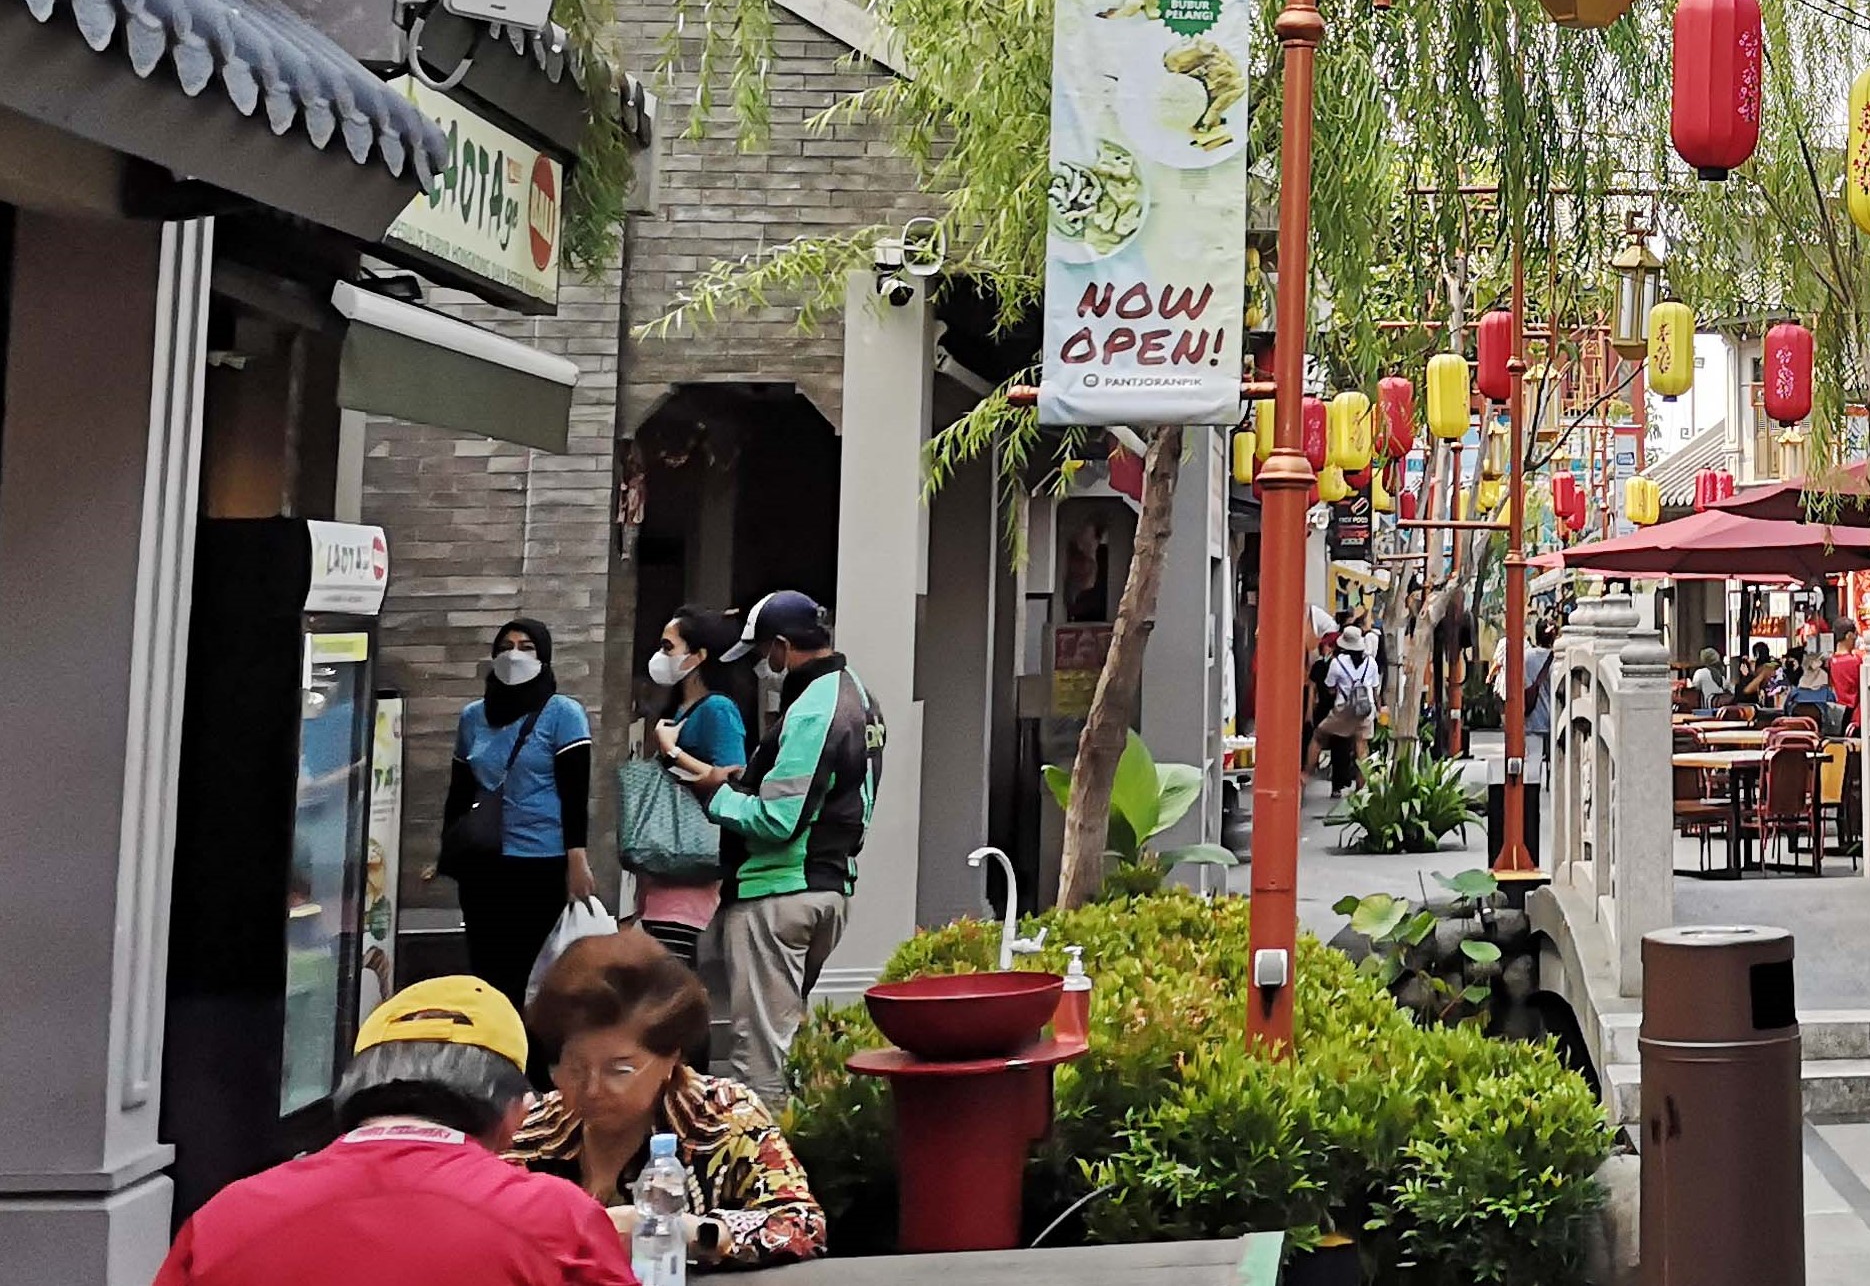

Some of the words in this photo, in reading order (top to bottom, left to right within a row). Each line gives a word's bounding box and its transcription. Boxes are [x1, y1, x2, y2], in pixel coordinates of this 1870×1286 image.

[1164, 9, 1214, 21] PELANGI
[1170, 0, 1210, 10] BUBUR
[429, 117, 503, 237] AOTA
[1077, 281, 1215, 320] NOW
[1060, 326, 1225, 367] OPEN!
